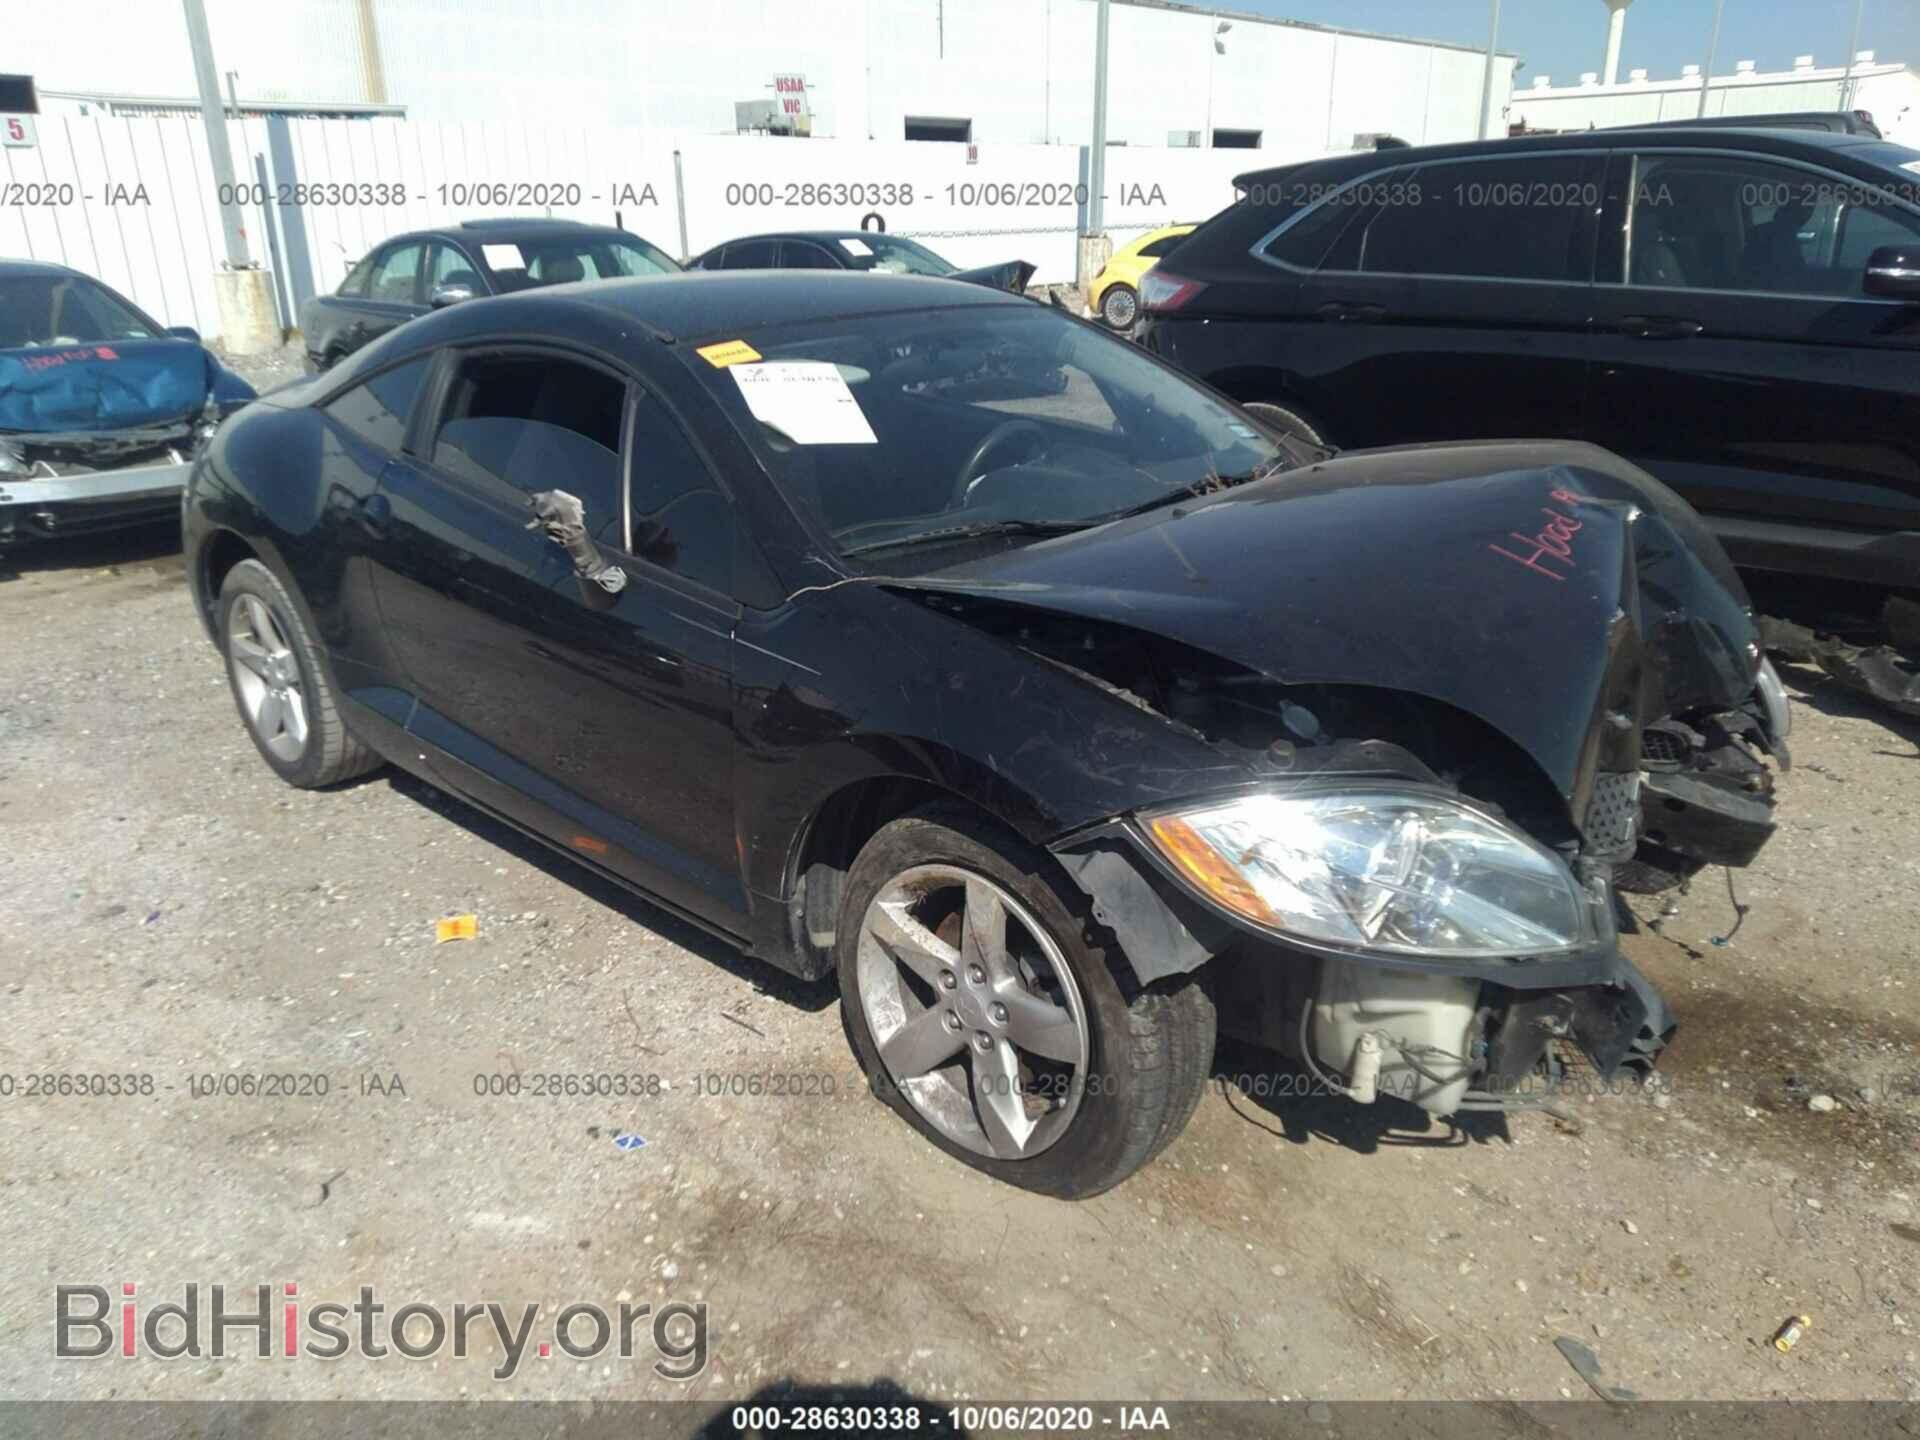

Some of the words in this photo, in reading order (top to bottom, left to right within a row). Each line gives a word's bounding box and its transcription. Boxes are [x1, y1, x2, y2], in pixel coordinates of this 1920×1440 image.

[775, 77, 804, 92] USAA
[783, 98, 801, 113] VIC
[8, 118, 25, 141] 5
